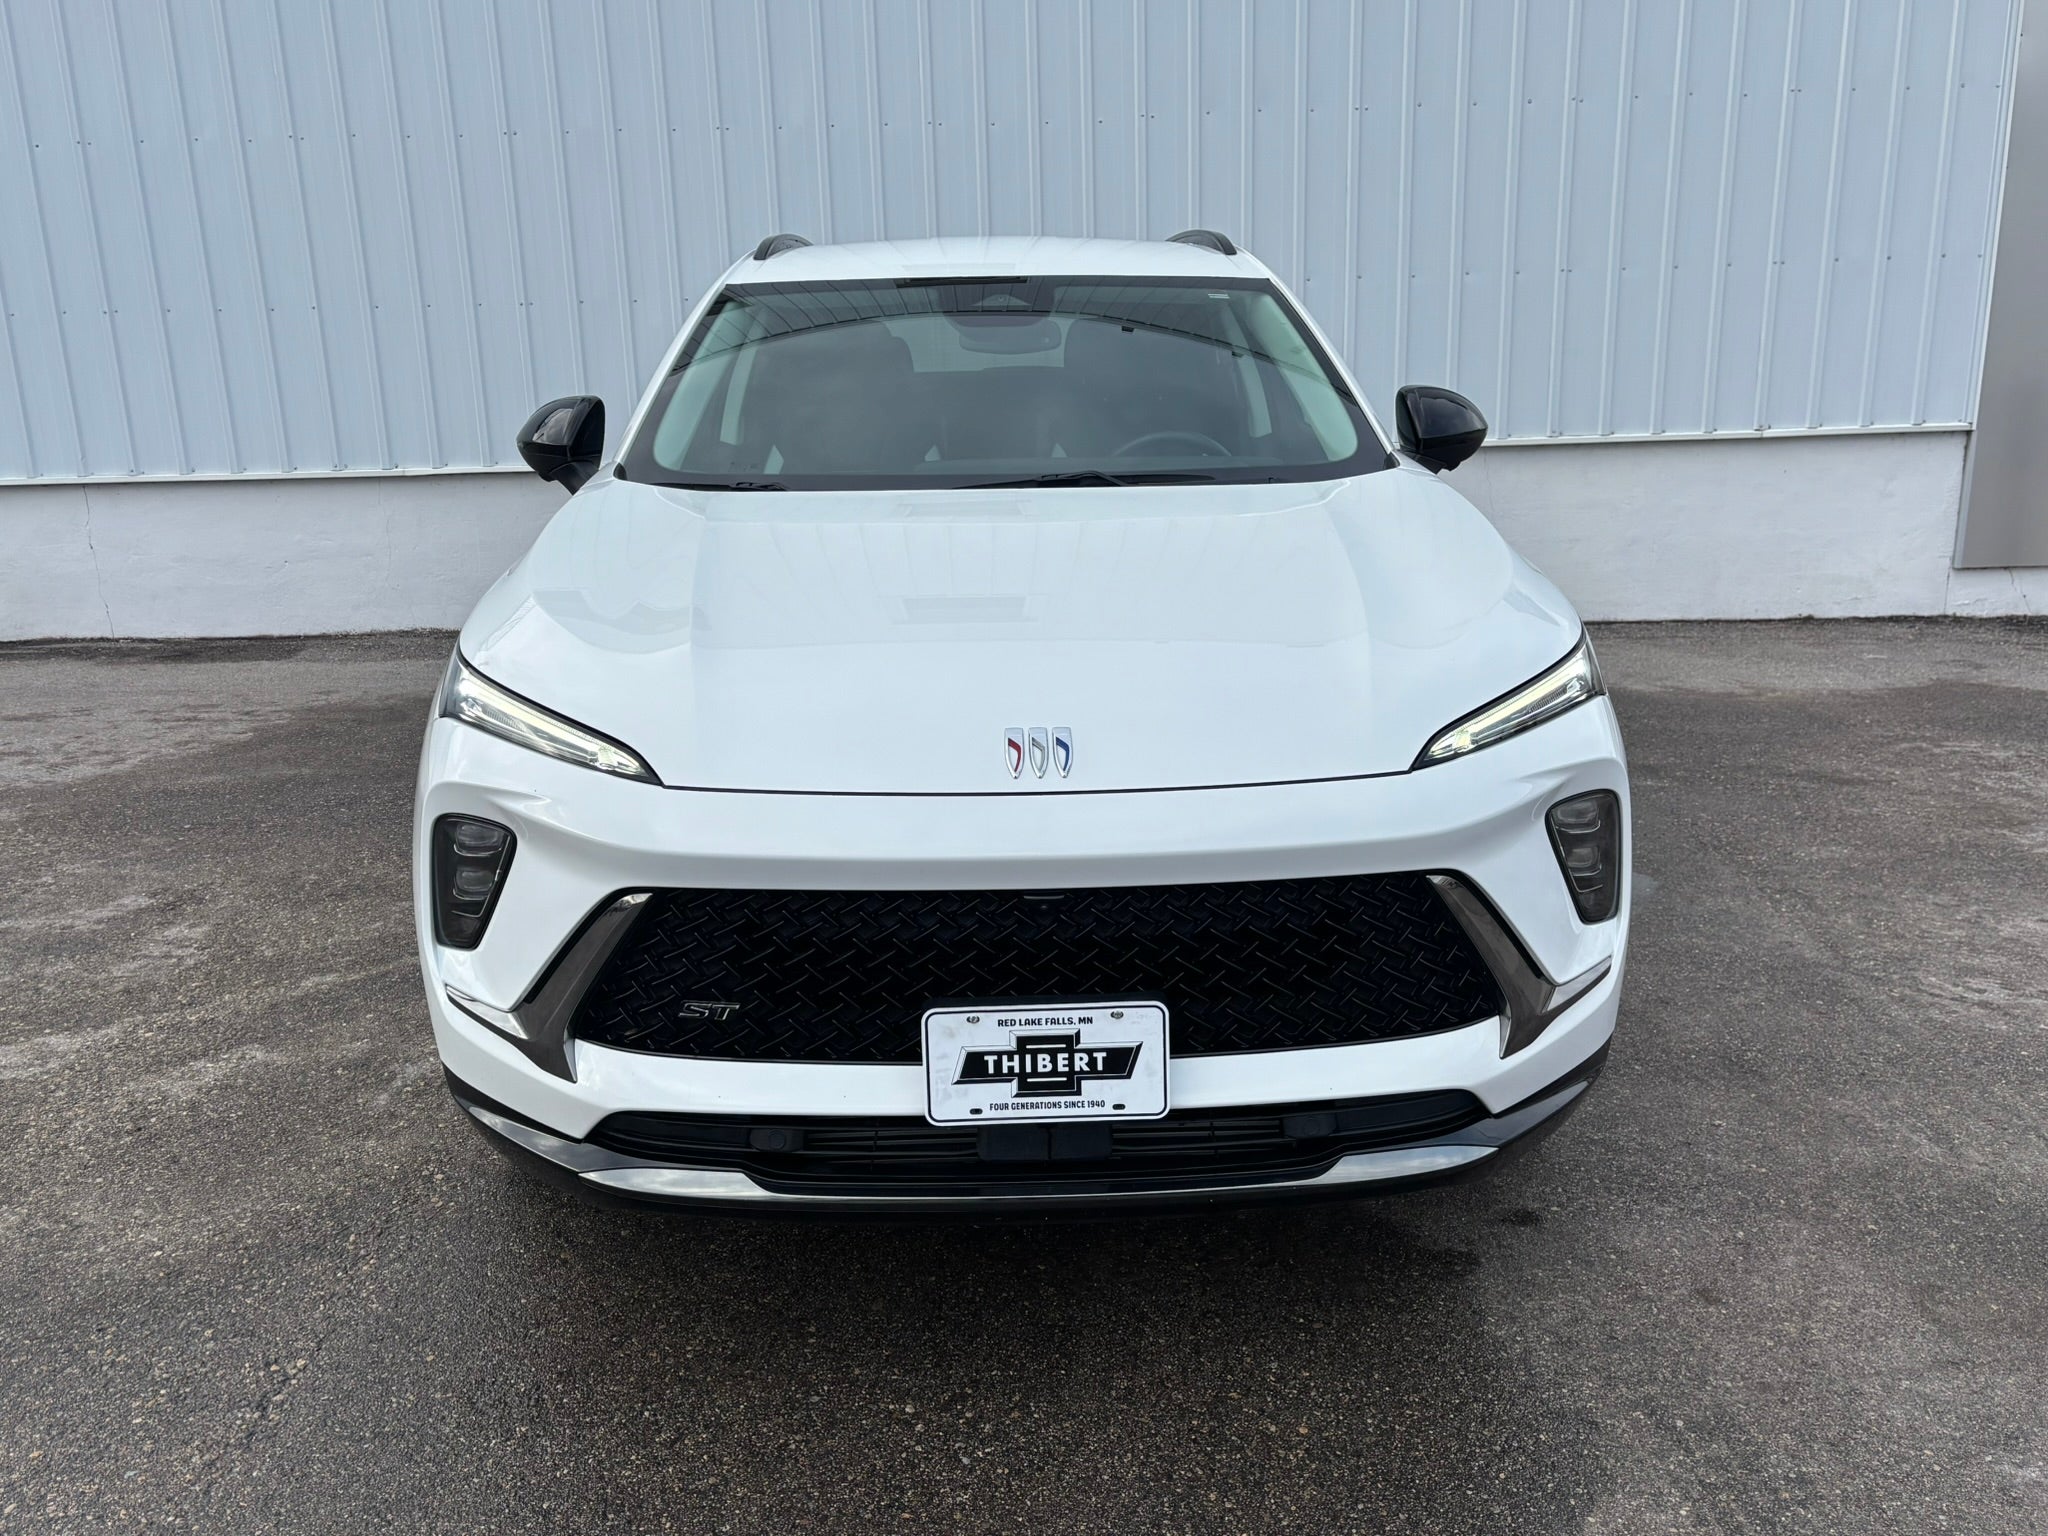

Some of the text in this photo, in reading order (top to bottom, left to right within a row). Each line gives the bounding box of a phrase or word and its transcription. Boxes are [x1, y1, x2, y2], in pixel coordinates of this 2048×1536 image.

[678, 1000, 740, 1020] ST
[997, 1016, 1094, 1027] RED LAKE FALLS, MN
[984, 1052, 1108, 1074] THIBERT
[989, 1099, 1106, 1111] FOUR GENERATIONS SINCE 1940
